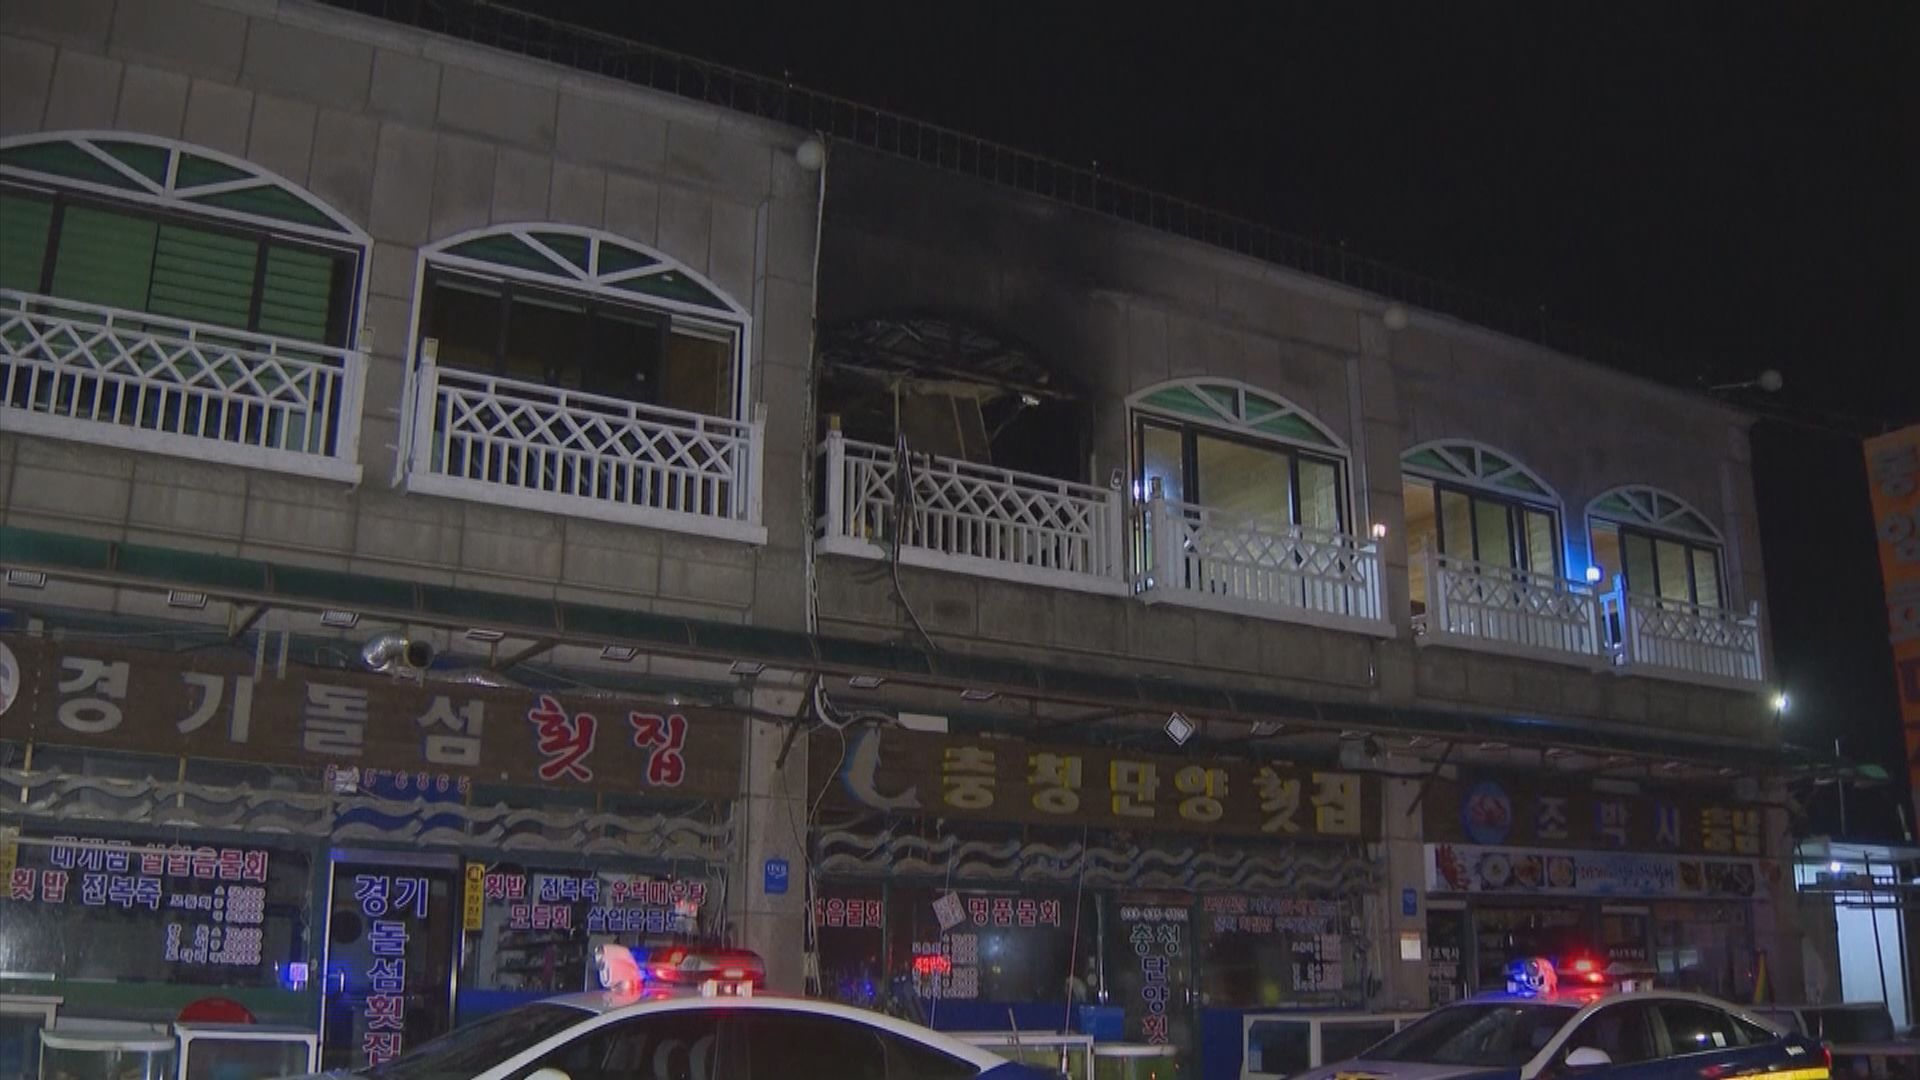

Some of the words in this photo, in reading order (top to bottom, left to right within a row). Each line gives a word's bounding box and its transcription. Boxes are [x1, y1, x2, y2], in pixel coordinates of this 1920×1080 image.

[82, 873, 162, 910] 전복죽
[355, 873, 430, 918] 경기
[541, 876, 600, 902] 전복죽
